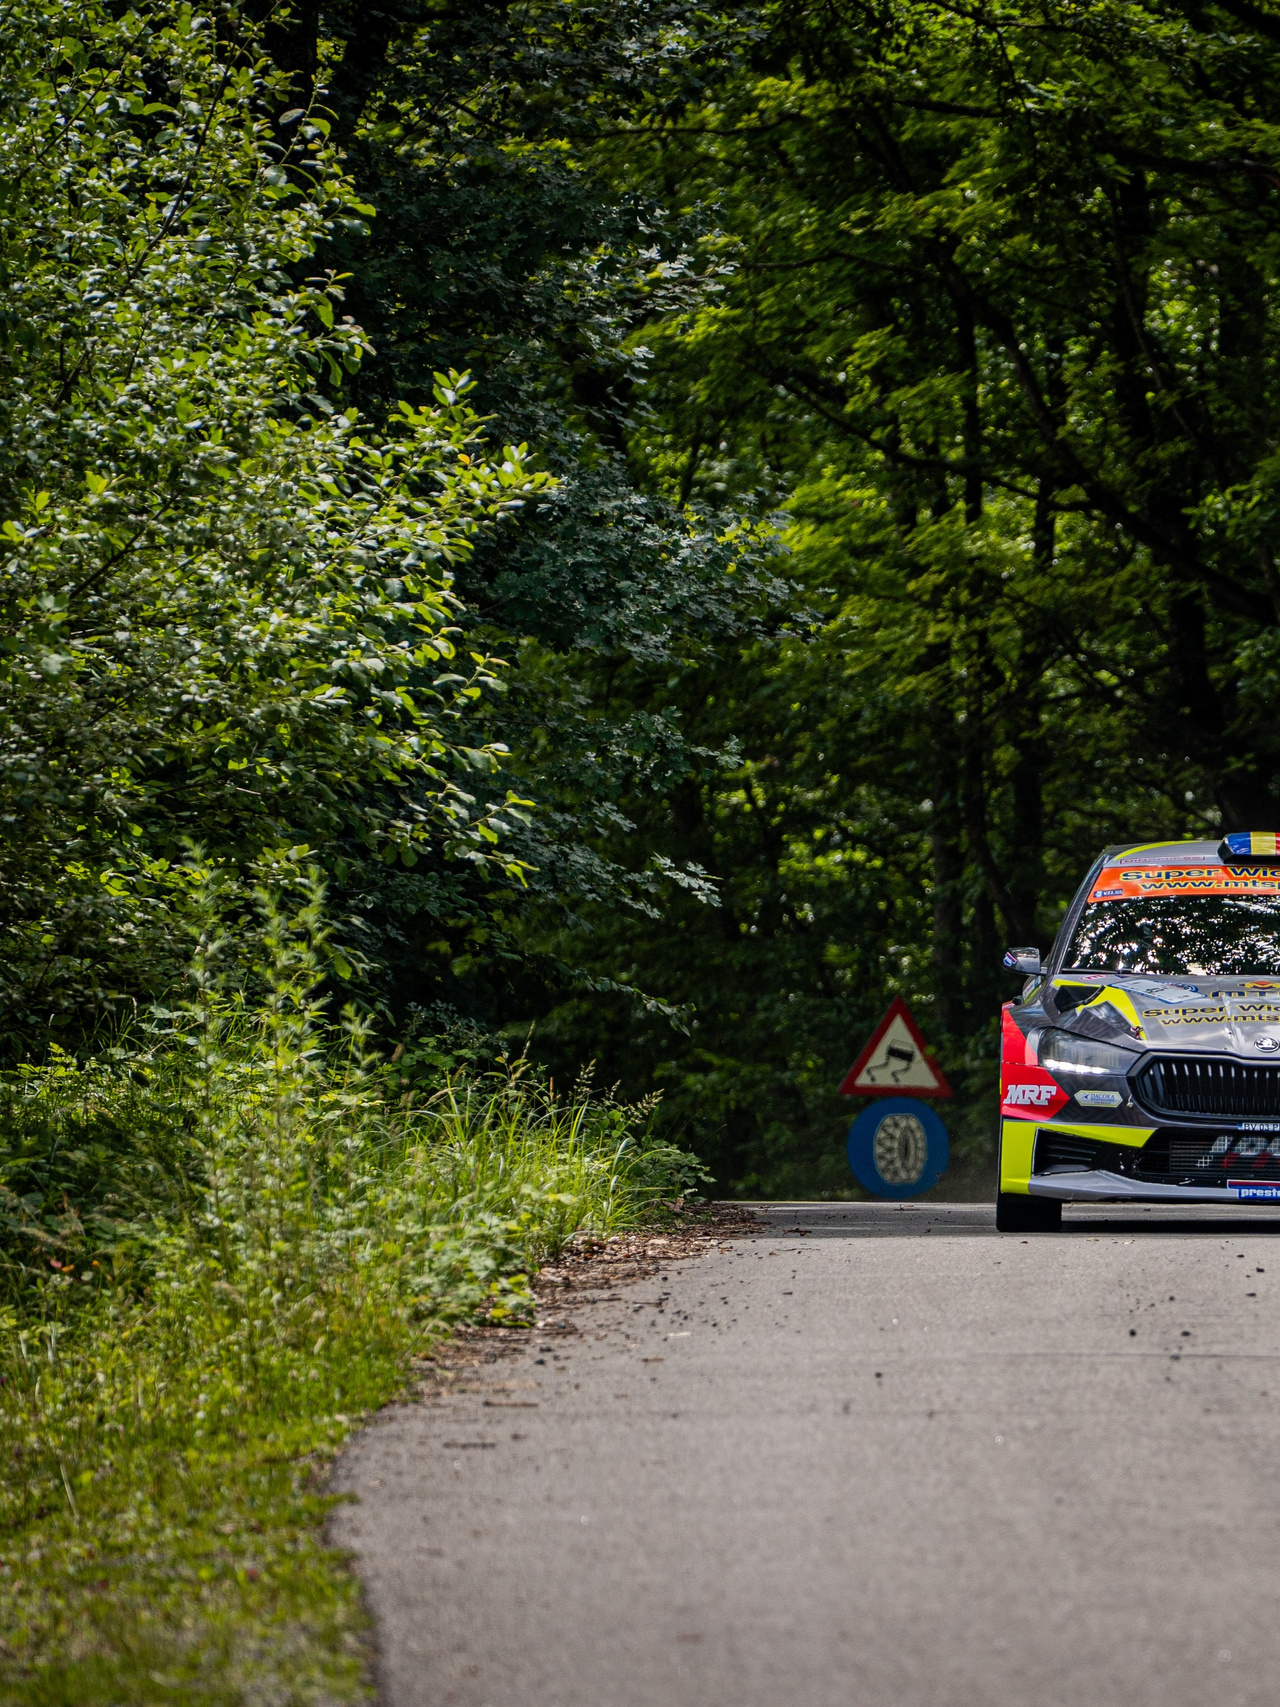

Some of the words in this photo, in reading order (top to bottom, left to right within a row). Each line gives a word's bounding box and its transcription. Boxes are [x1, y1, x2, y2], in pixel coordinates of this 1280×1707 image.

[1119, 868, 1221, 881] Super
[1142, 1006, 1226, 1017] Super
[1003, 1084, 1057, 1106] MRF
[1243, 1123, 1257, 1131] BV
[1259, 1123, 1270, 1131] 03
